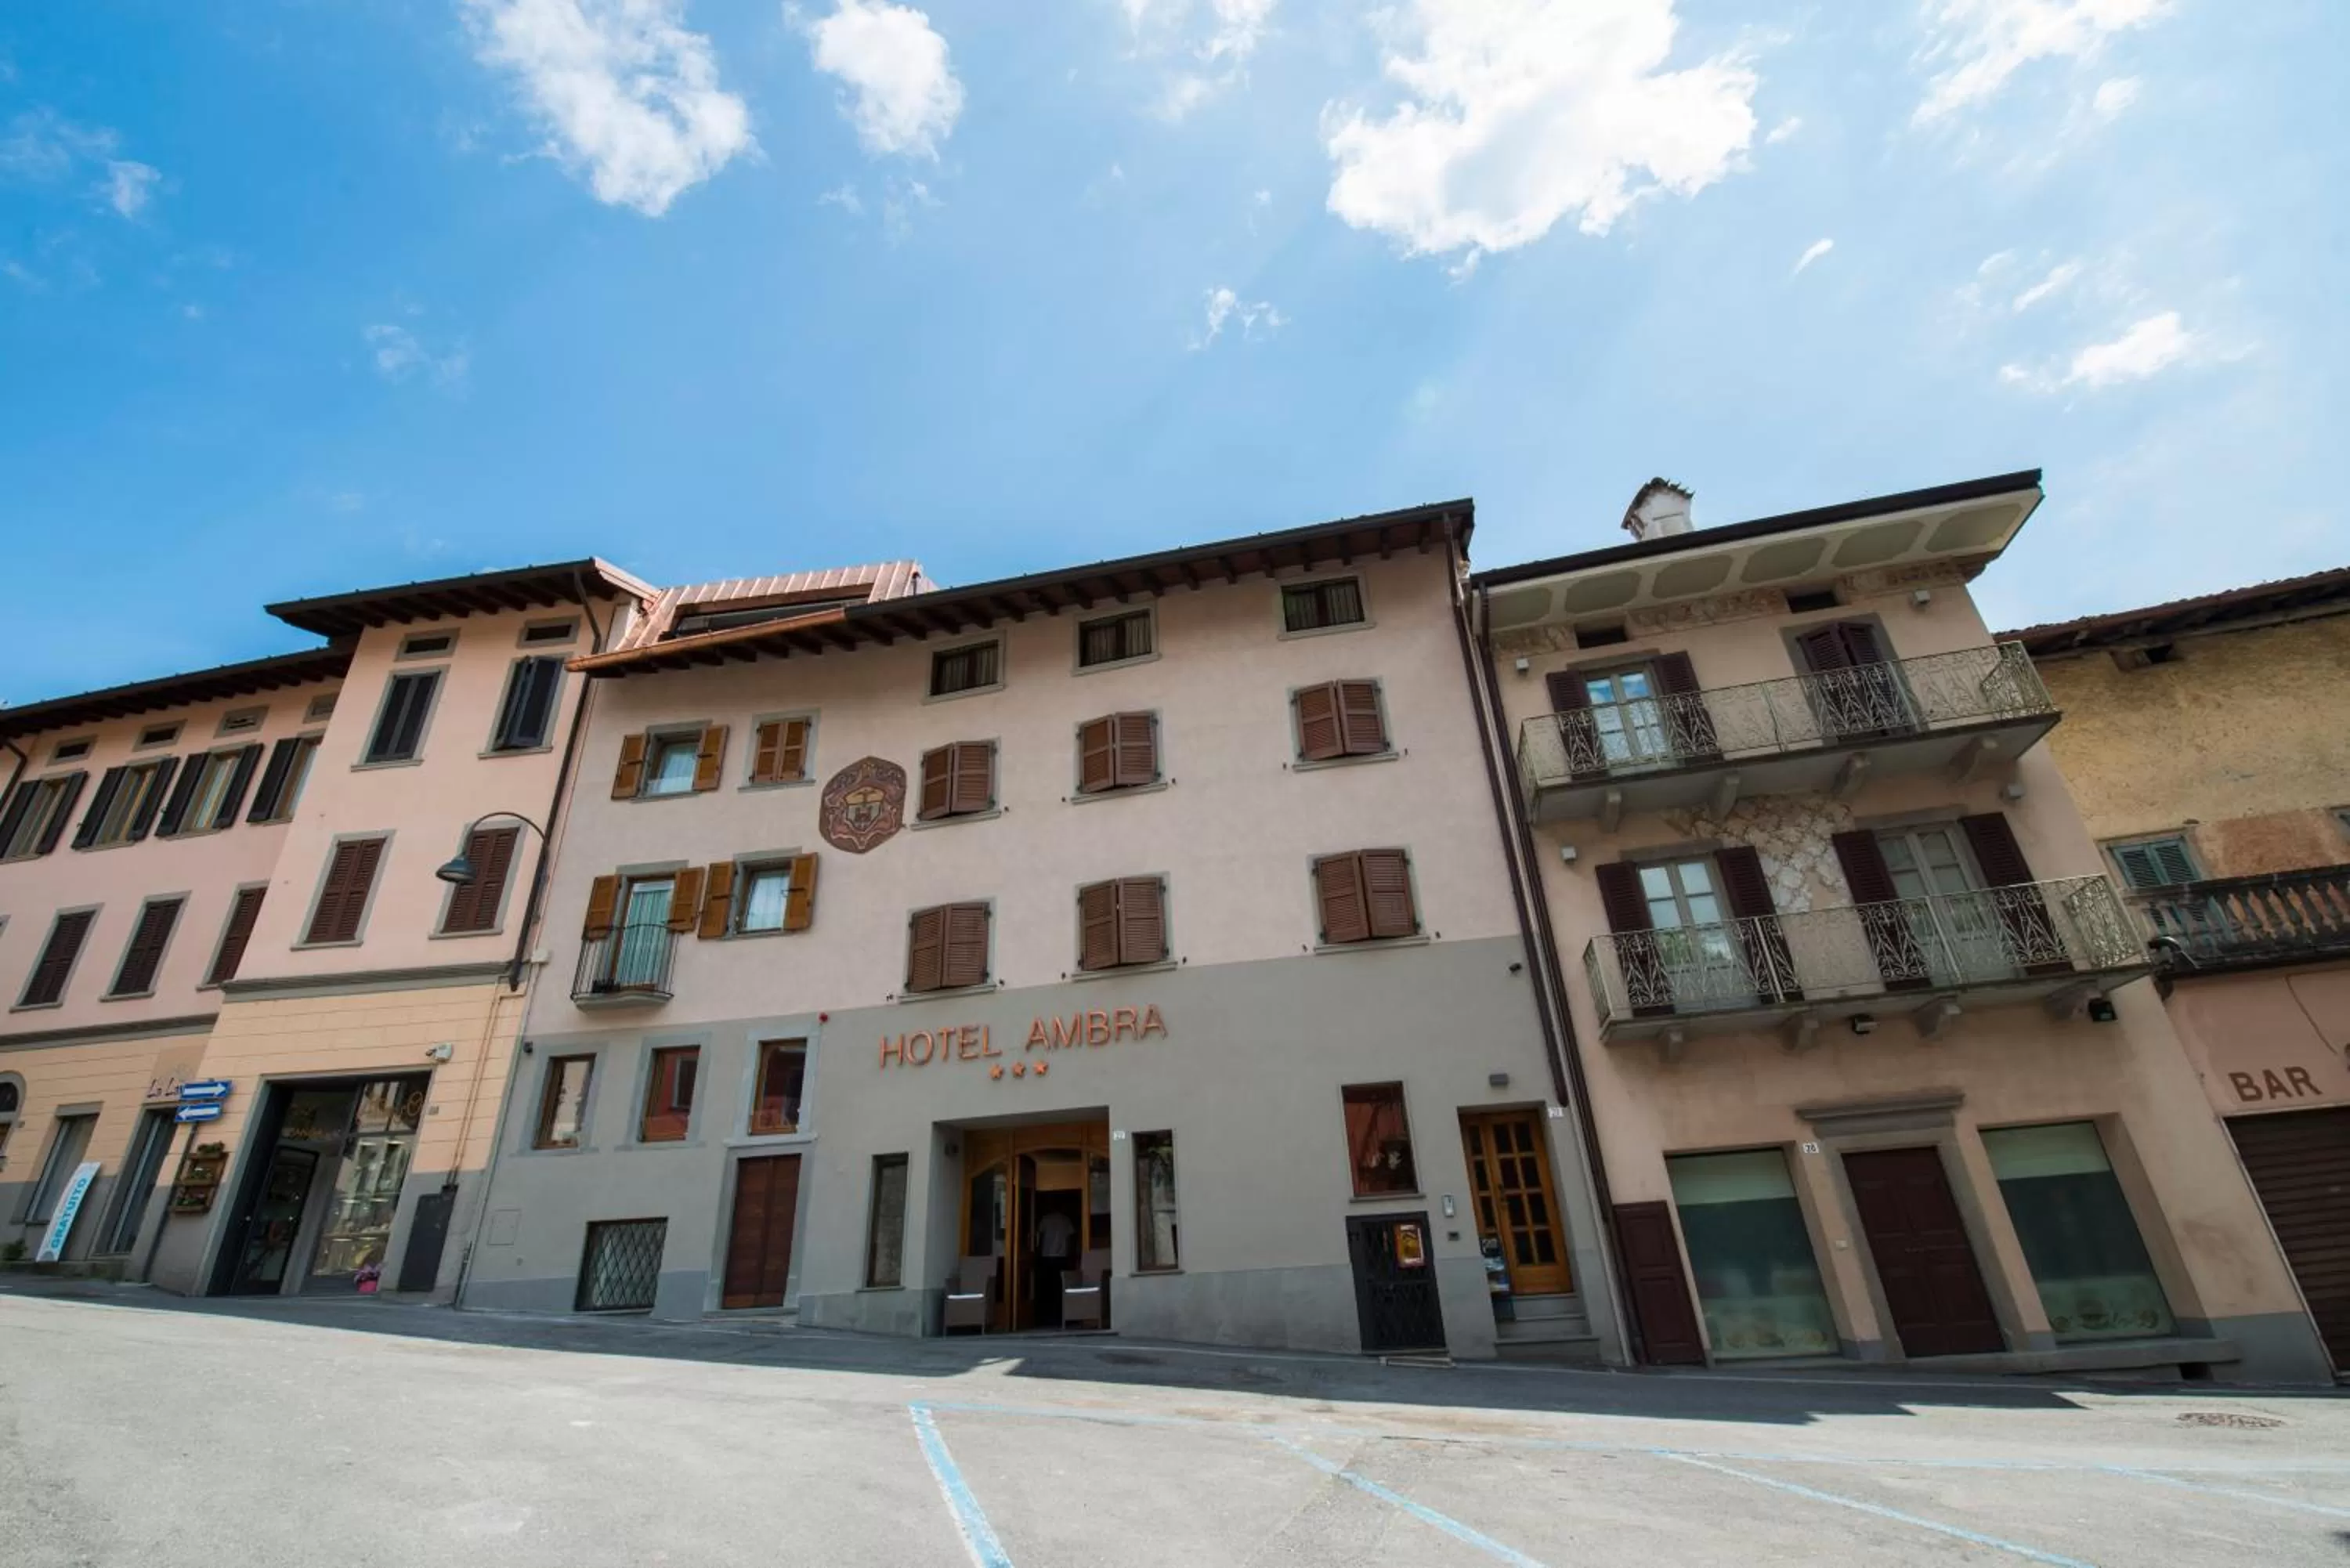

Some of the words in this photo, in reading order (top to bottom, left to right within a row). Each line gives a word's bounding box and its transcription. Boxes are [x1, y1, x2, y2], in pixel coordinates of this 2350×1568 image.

[879, 1024, 1002, 1068] HOTEL
[1025, 1003, 1168, 1053] AMBRA
[2228, 1066, 2323, 1102] BAR
[51, 1177, 87, 1249] GRATUITO
